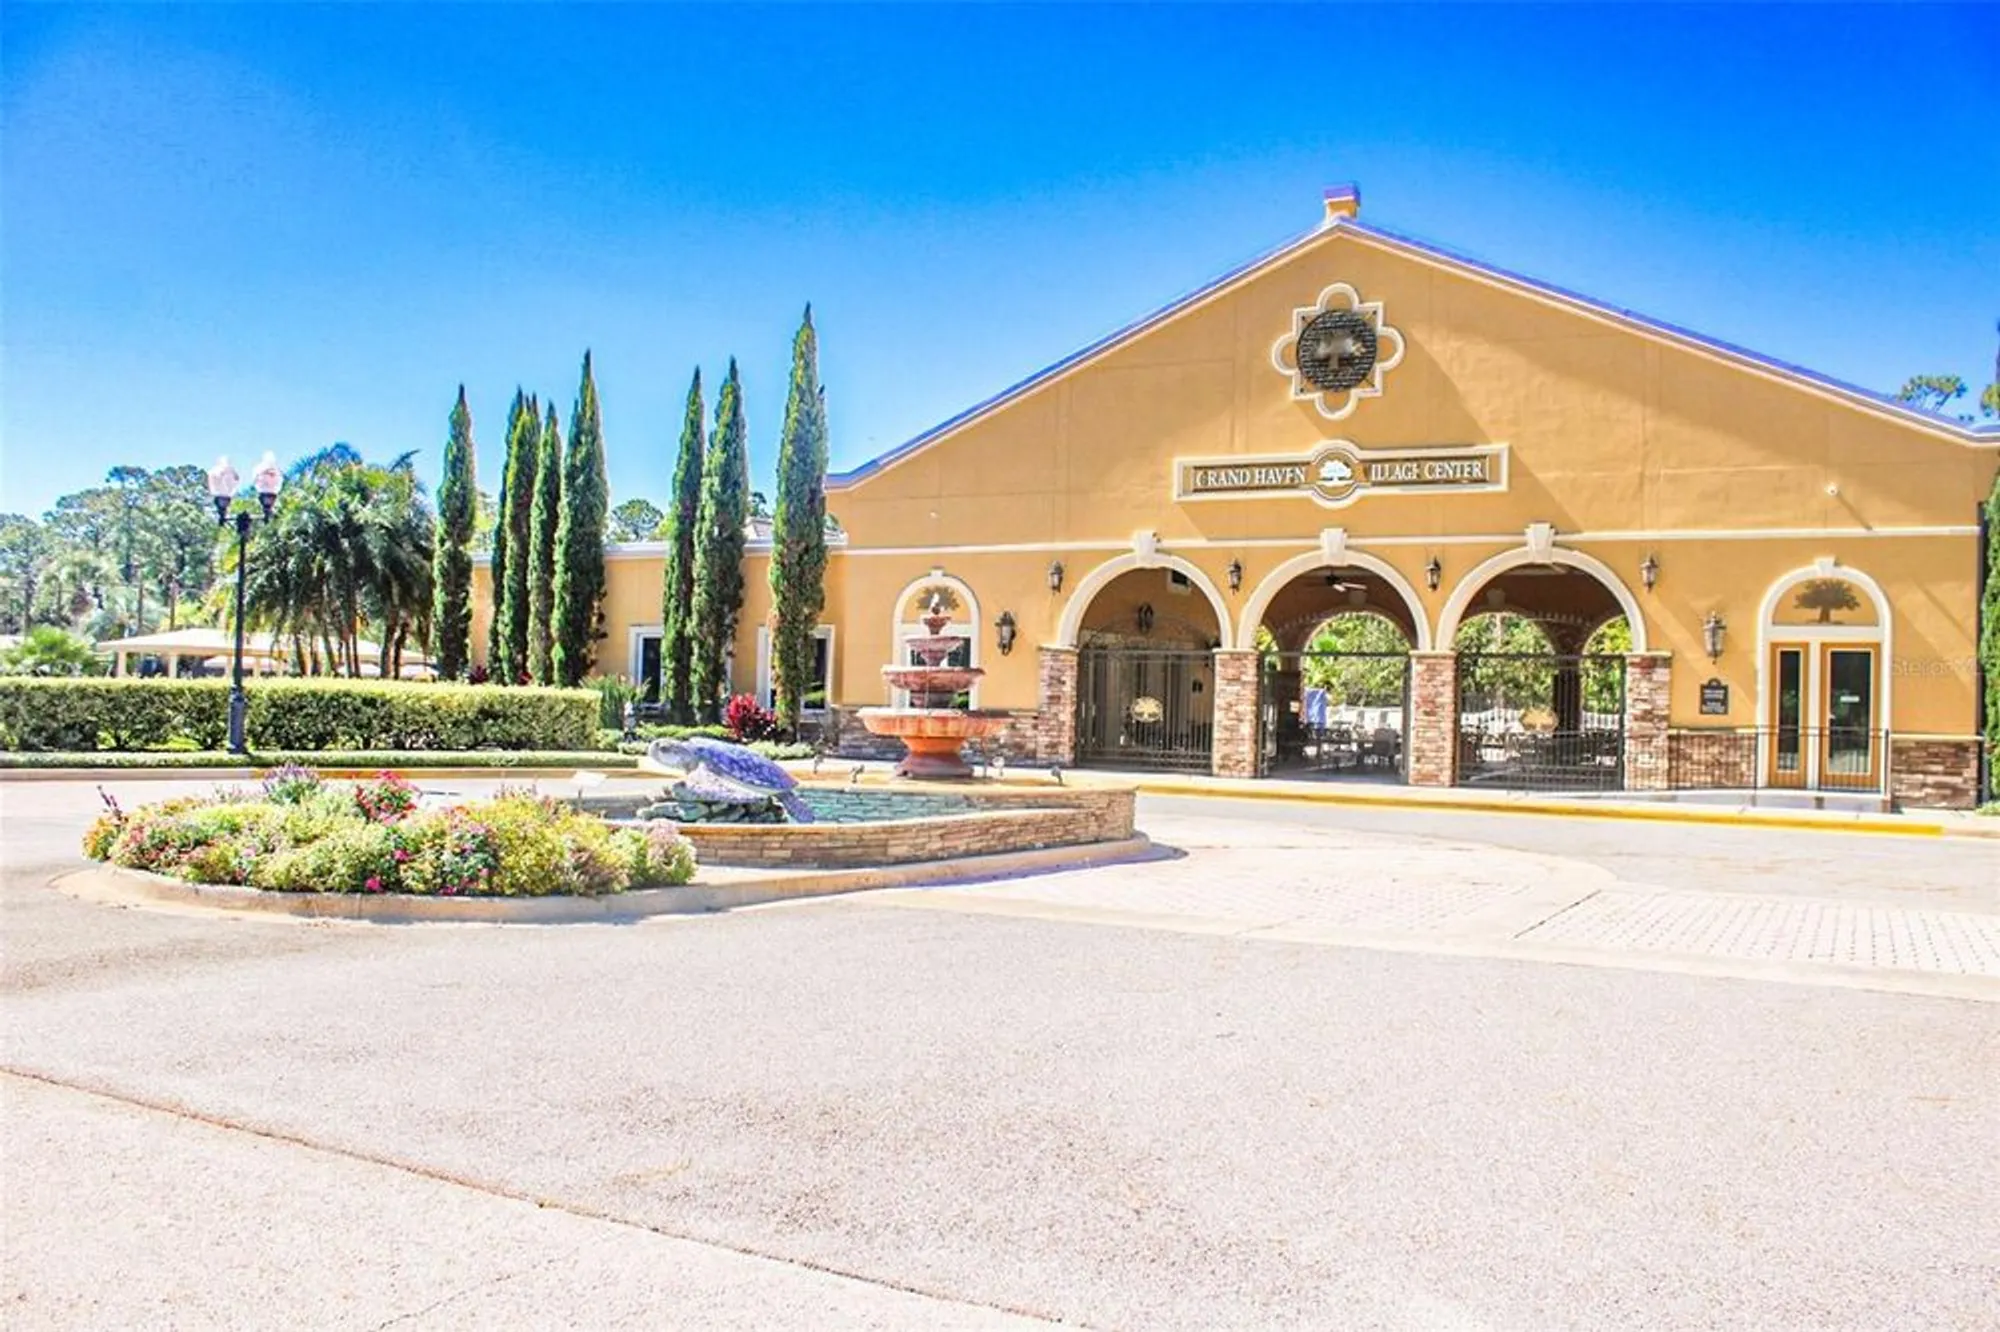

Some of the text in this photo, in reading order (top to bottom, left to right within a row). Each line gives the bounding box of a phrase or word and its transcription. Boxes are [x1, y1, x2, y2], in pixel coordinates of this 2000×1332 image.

[1196, 467, 1251, 487] GRAND
[1254, 466, 1306, 485] HAVEN
[1424, 460, 1483, 480] CENTER
